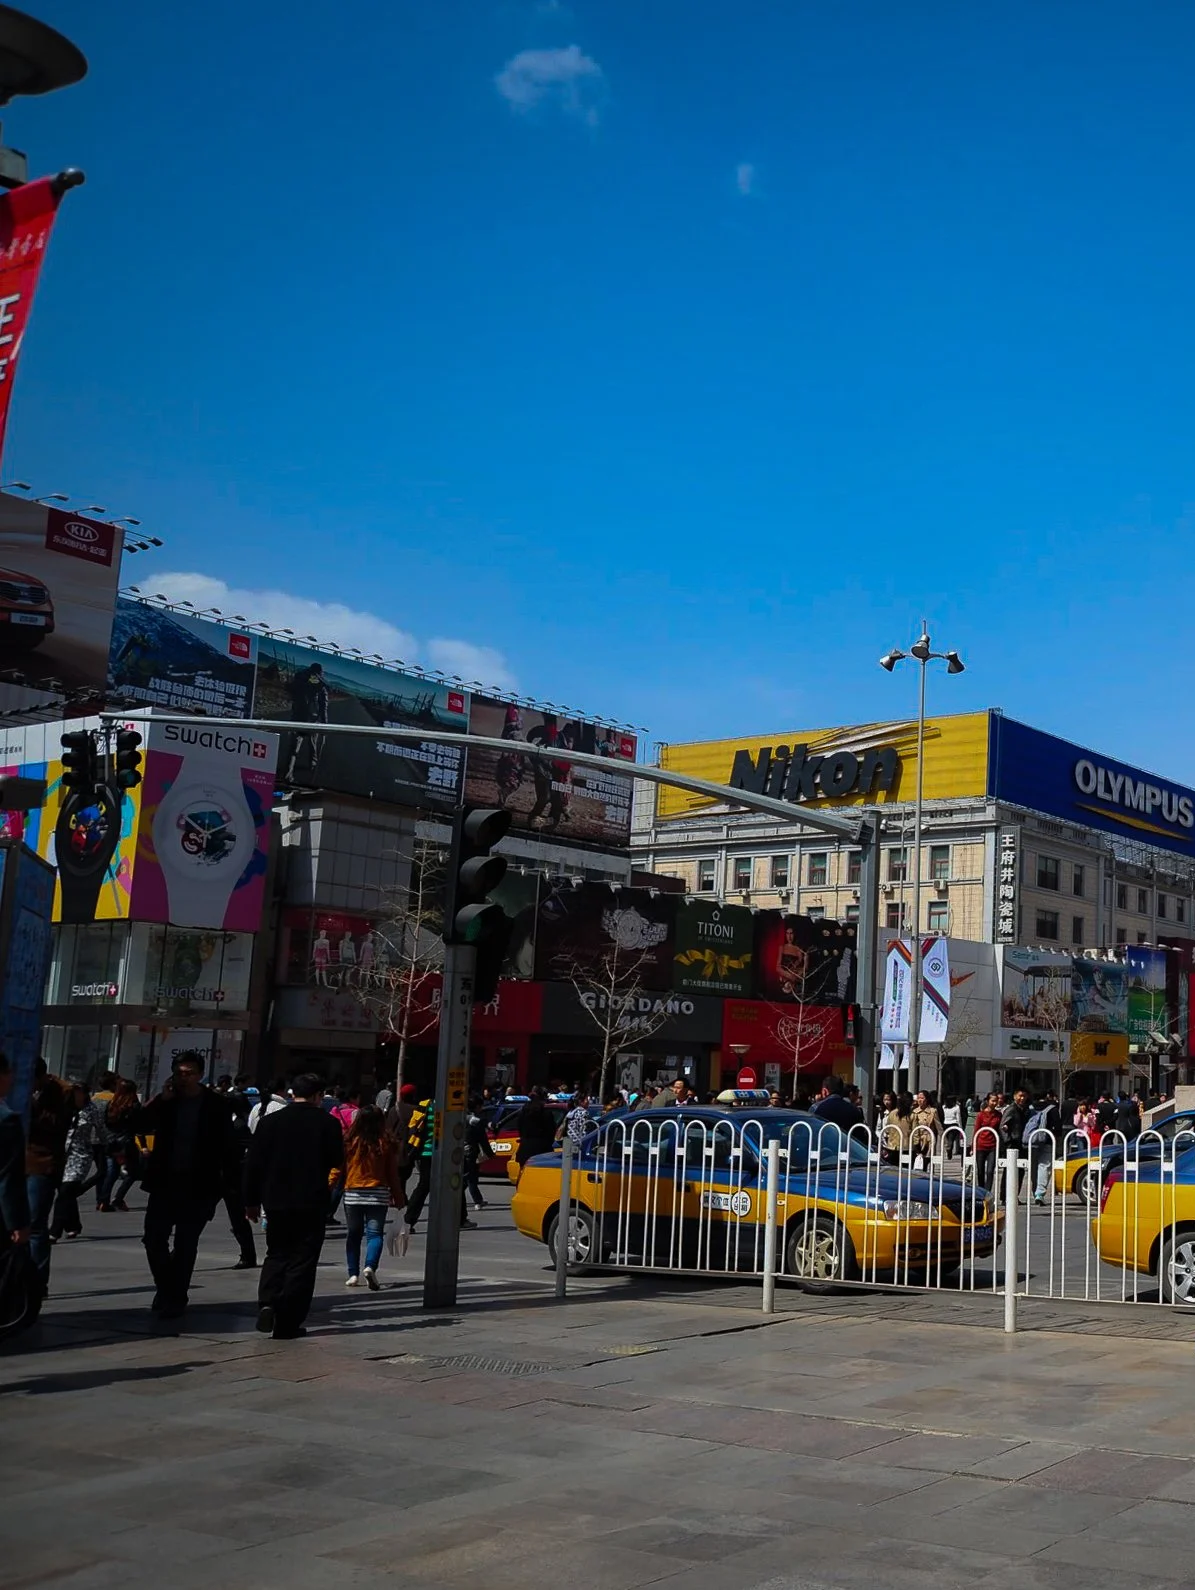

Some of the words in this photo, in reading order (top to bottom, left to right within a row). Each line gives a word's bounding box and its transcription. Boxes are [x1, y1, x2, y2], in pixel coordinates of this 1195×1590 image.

[71, 524, 94, 539] KIA
[165, 725, 251, 755] swatch
[729, 742, 899, 802] Nikon
[1075, 759, 1194, 828] OLYMPUS
[999, 834, 1015, 934] 王府井陶瓷城
[697, 921, 734, 939] TITONI
[72, 982, 110, 997] swatch
[581, 992, 694, 1015] GIORDANO
[1010, 1035, 1047, 1051] Semir
